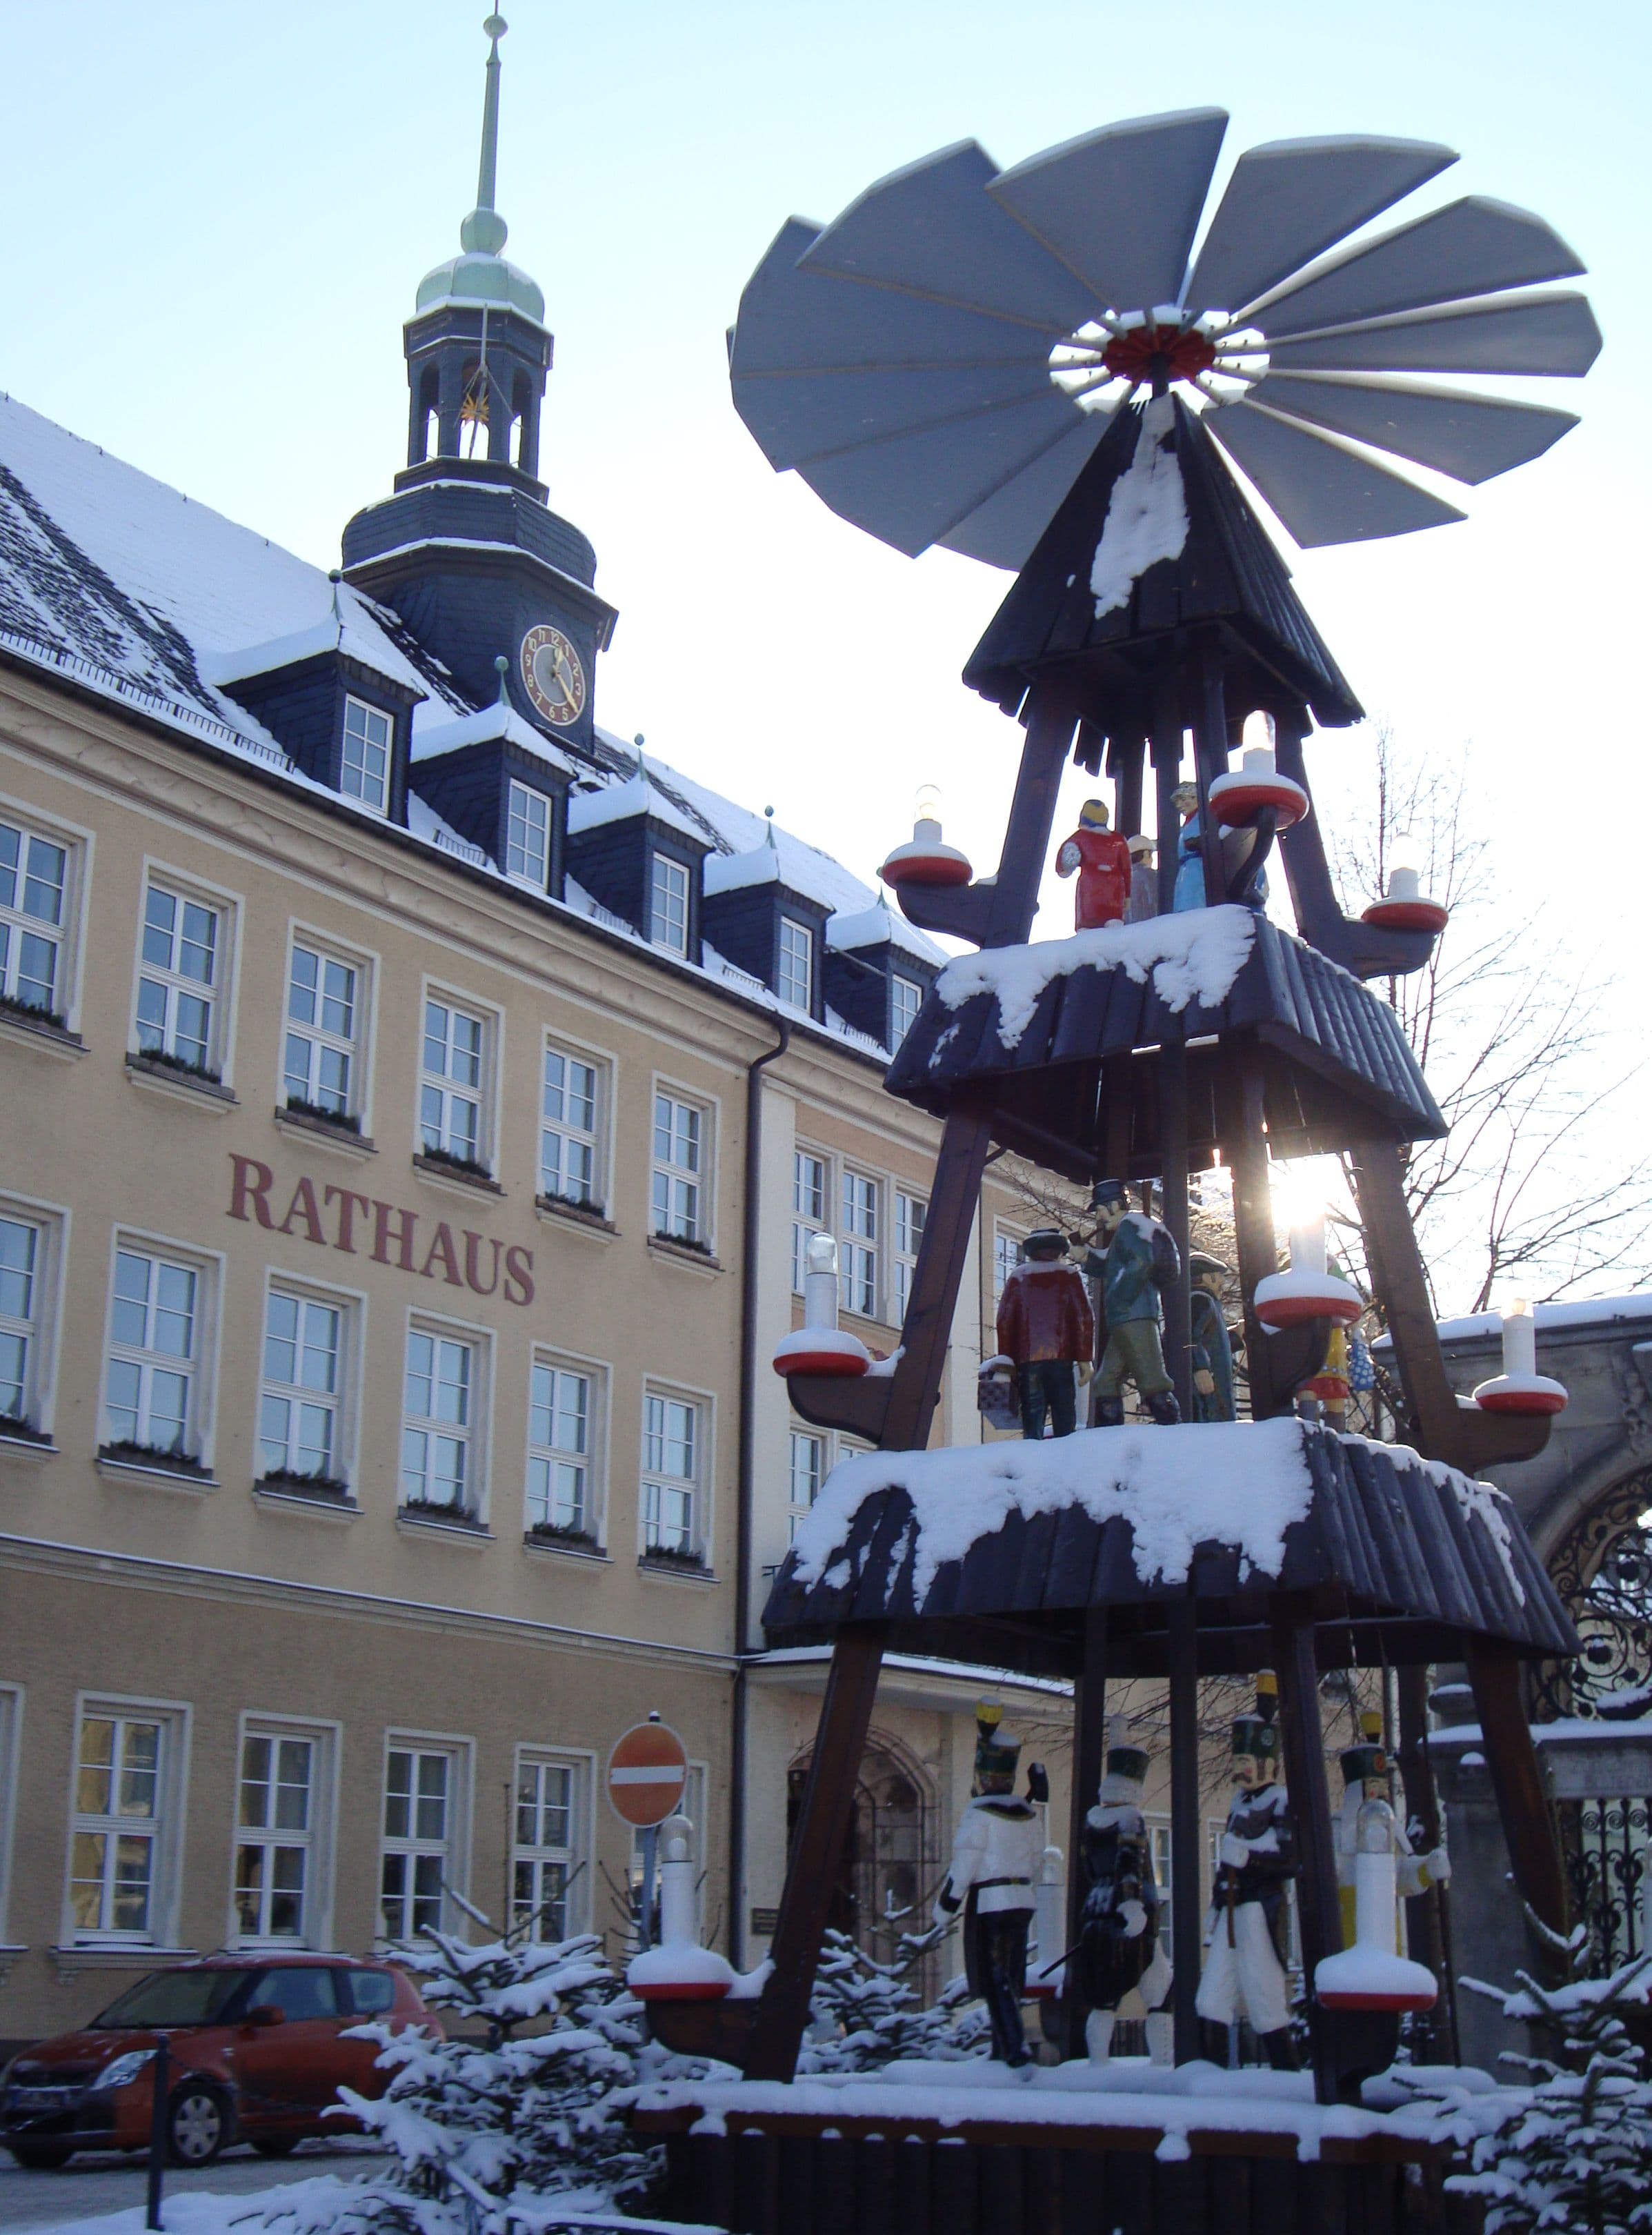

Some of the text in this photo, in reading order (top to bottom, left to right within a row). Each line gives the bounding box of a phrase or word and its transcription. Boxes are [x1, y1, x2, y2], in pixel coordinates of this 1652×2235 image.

[539, 629, 546, 643] 11
[551, 631, 560, 646] 12
[528, 637, 537, 651] 10
[565, 644, 570, 657] 1
[525, 654, 531, 666] 9
[573, 663, 579, 676] 2
[527, 674, 534, 687] 8
[575, 683, 581, 696] 3
[536, 693, 542, 704] 7
[549, 706, 555, 719] 6
[562, 707, 568, 721] 5
[225, 1153, 535, 1307] RATHAUS
